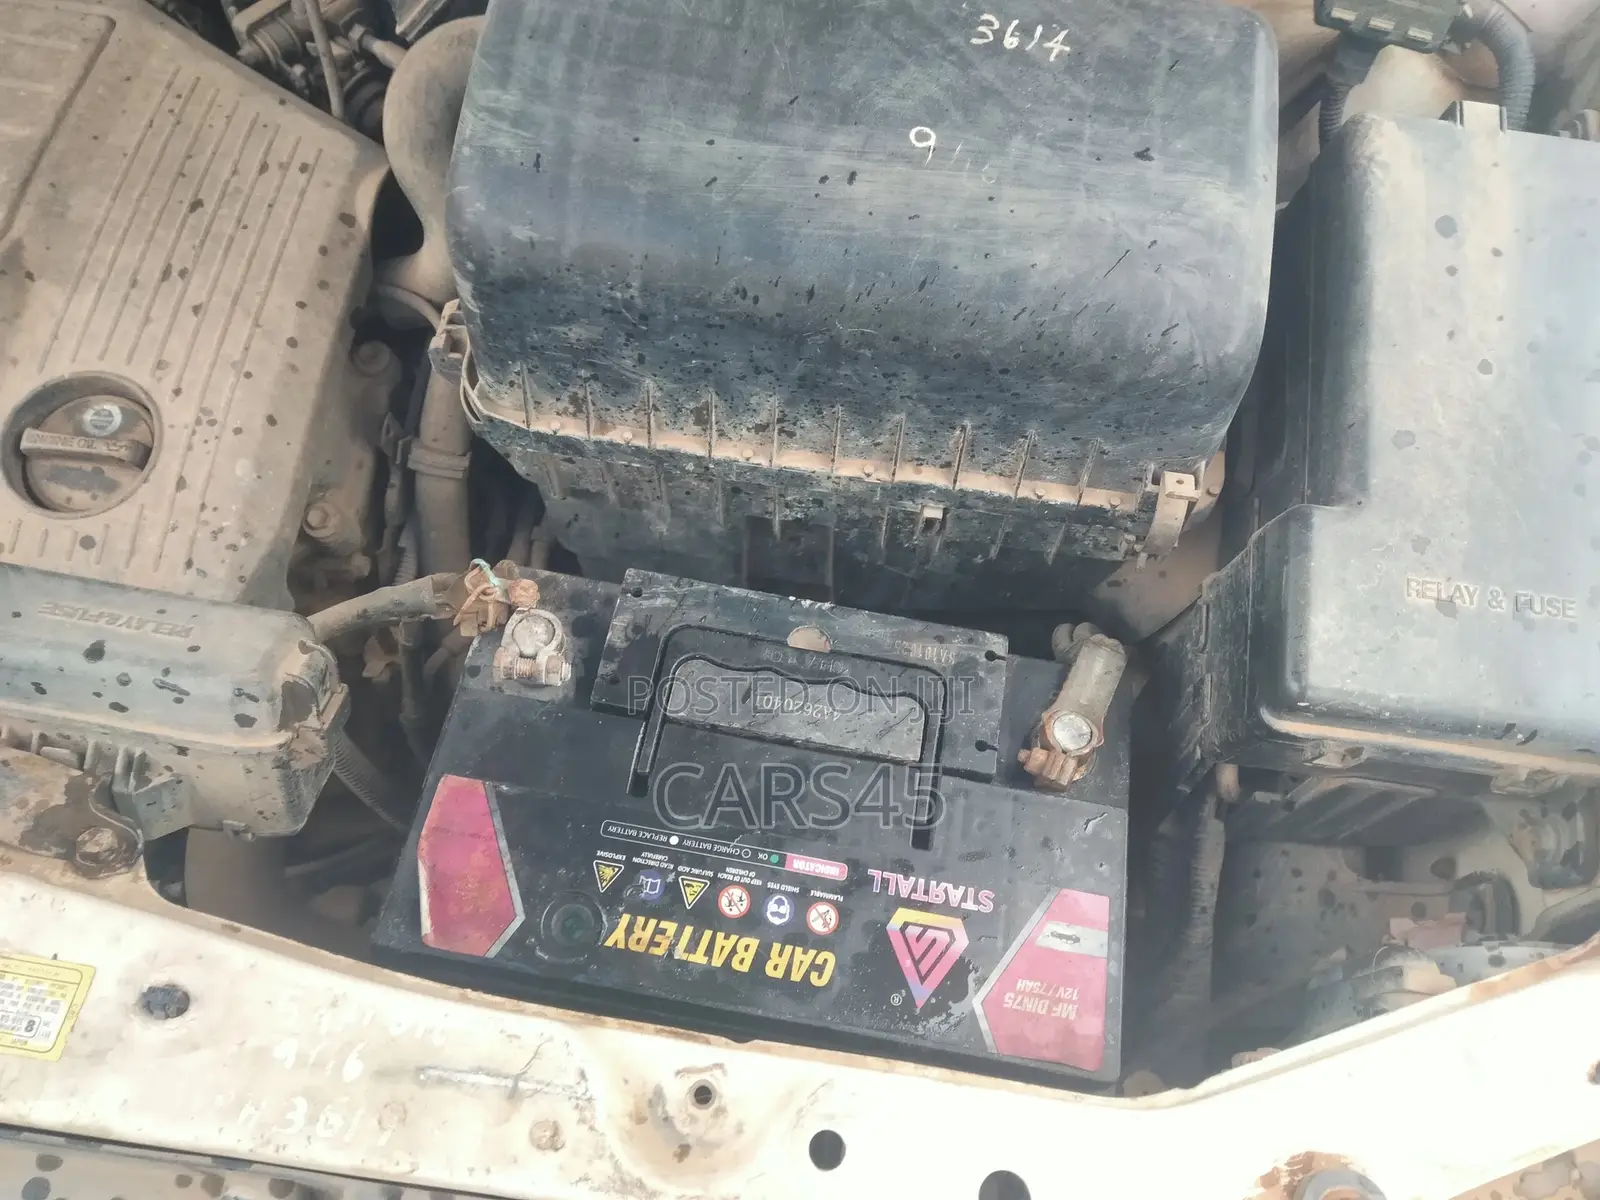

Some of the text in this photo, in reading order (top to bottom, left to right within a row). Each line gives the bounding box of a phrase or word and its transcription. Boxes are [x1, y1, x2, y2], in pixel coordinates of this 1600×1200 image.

[969, 13, 1071, 62] 3614
[1406, 577, 1577, 618] RELAY & FUSE
[606, 824, 668, 842] REPLACE BATTERY
[681, 837, 740, 856] CHARGE BATTERY
[596, 849, 626, 860] EXPLOSIVE
[632, 856, 659, 866] DIRECTION
[640, 851, 668, 861] CAREFULLY
[756, 851, 840, 875] INDICATOR OK
[677, 864, 714, 877] SULFURIC ACID
[716, 872, 733, 880] REACH
[725, 866, 748, 876] CHILDREN
[766, 881, 799, 893] SHIELD EYES
[809, 889, 844, 901] FLAMMABLE
[604, 912, 836, 987] CAR BATTERY
[1055, 986, 1080, 1000] 12V
[1003, 992, 1079, 1020] MF DIN75
